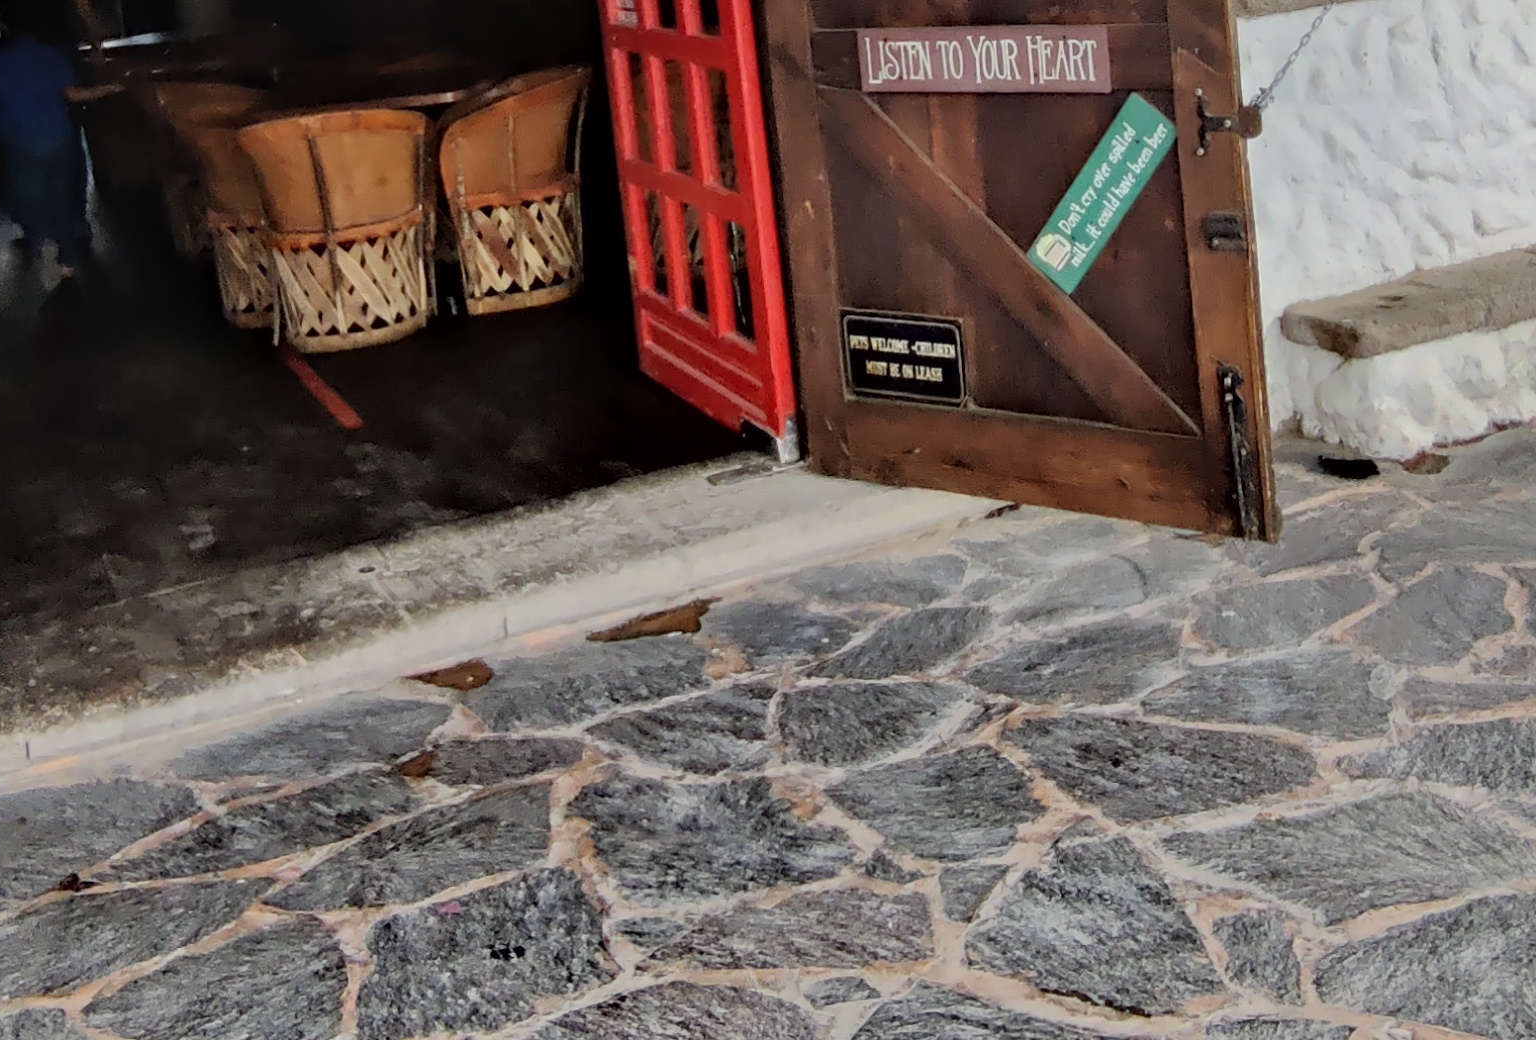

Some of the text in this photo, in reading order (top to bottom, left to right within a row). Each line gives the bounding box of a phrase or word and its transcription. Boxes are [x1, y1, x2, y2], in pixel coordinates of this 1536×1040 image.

[865, 35, 1097, 85] LISTEN TO YOUR HEART
[1081, 185, 1098, 207] cry
[1093, 162, 1111, 189] over
[1108, 121, 1137, 164] spilled
[1085, 224, 1102, 240] it
[1098, 192, 1121, 228] could
[1112, 171, 1137, 200] have
[1126, 146, 1154, 174] been
[1143, 123, 1168, 148] beer
[849, 334, 869, 350] PETS
[870, 336, 910, 354] WELCOME
[865, 359, 888, 376] MUST
[889, 362, 901, 378] BE
[915, 365, 943, 382] LEASH
